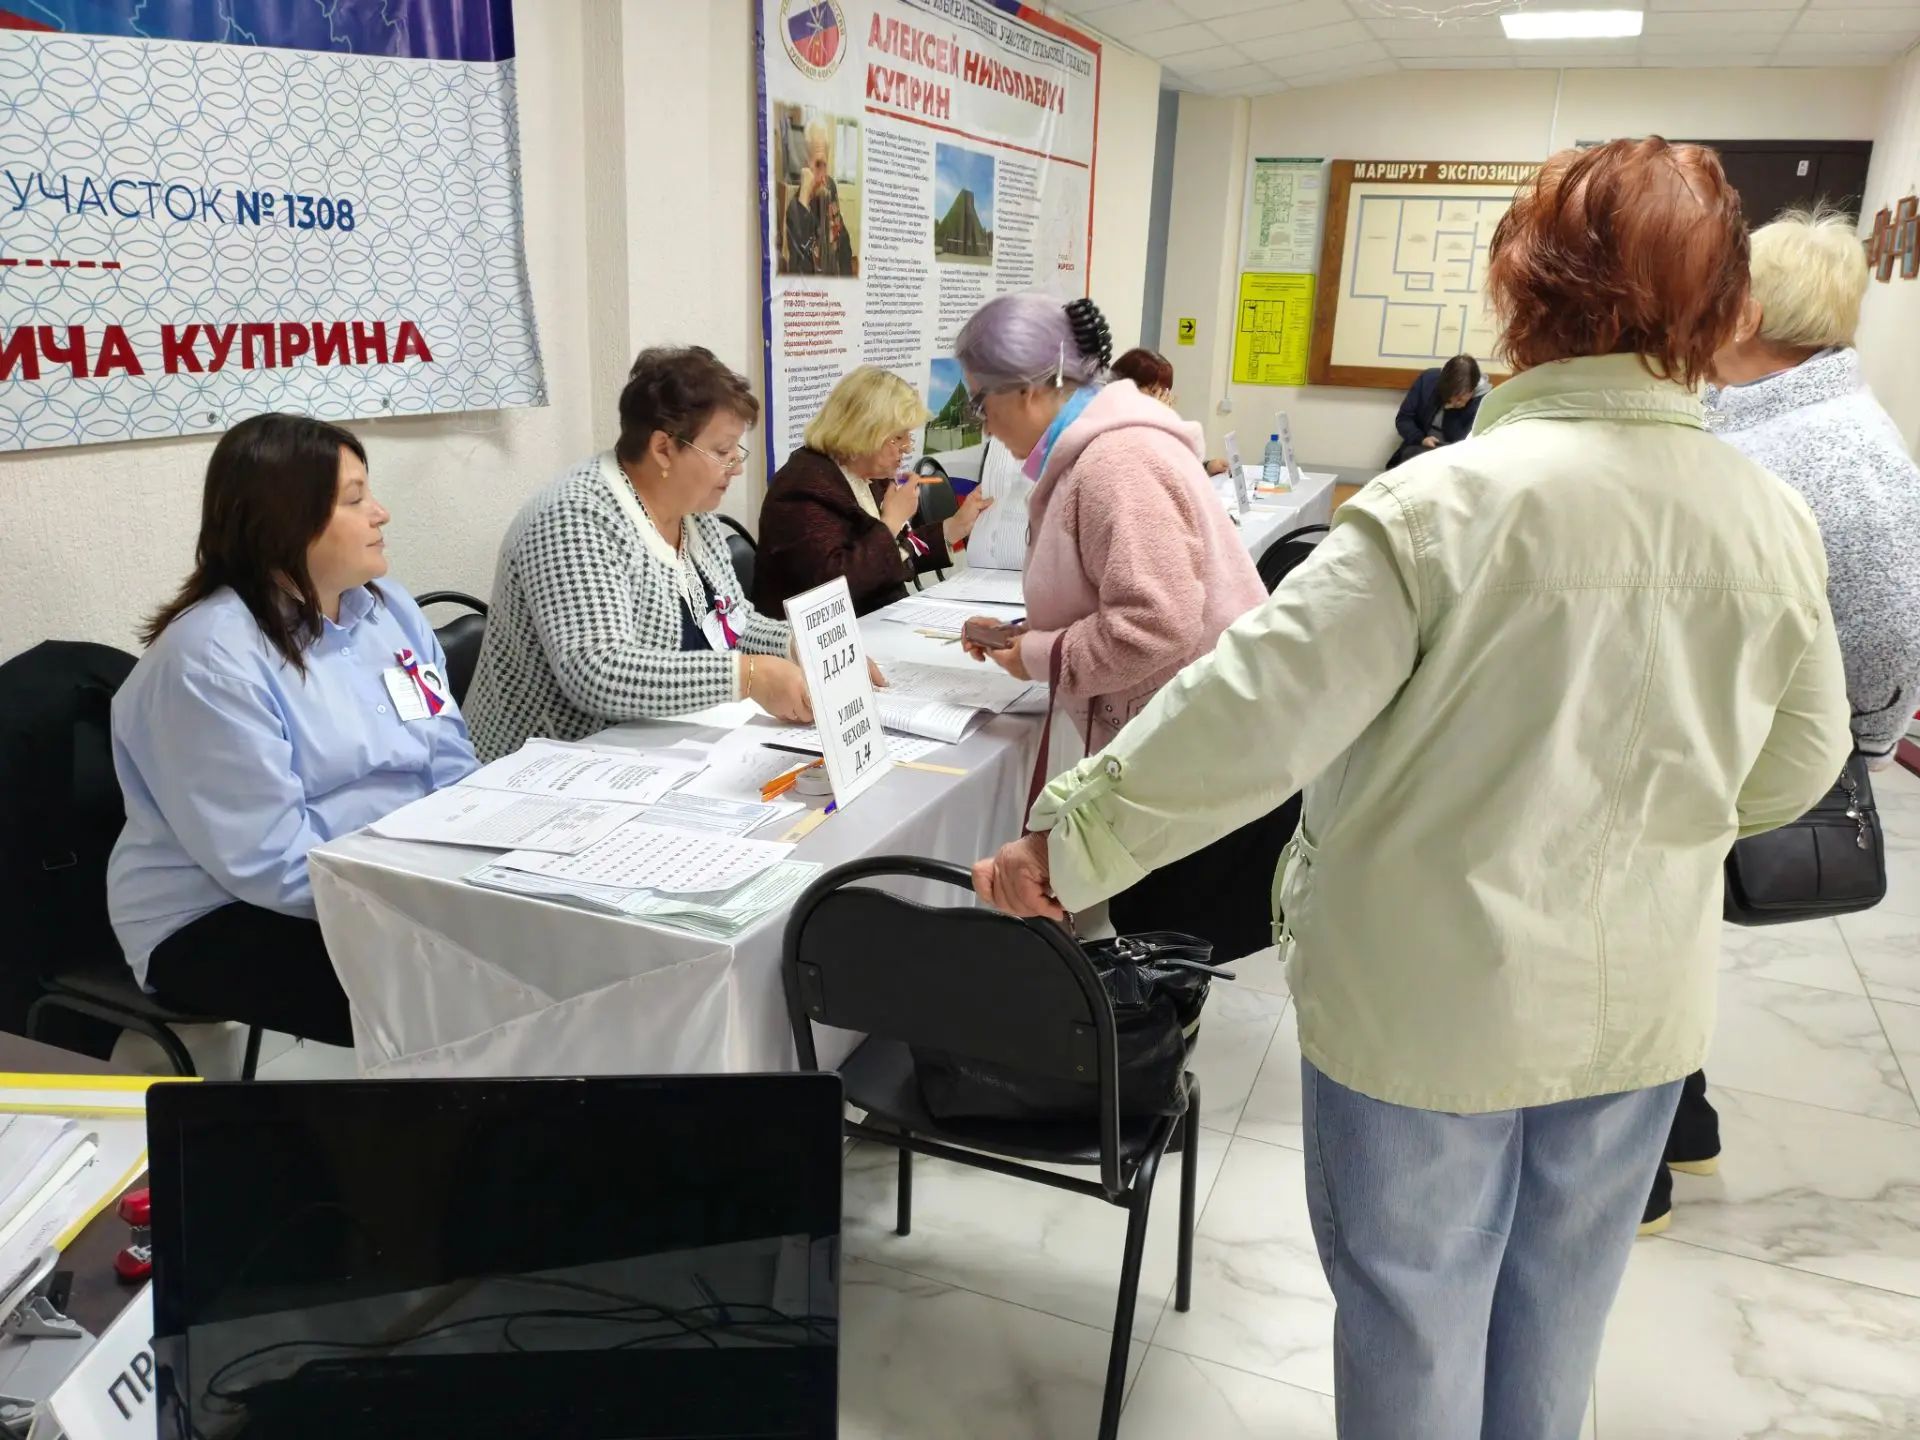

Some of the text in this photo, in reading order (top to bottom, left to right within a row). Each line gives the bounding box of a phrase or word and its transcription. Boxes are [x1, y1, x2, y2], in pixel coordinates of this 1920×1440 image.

[867, 12, 959, 78] АЛЕКСЕЙ
[866, 63, 950, 120] КУПРИН
[1354, 163, 1427, 180] МАРШРУТ
[5, 169, 355, 231] УЧАСТОК № 1308
[160, 320, 434, 374] КУПРИНА
[805, 597, 847, 631] ПЕРЕУЛОК
[817, 622, 848, 650] ЧЕХОВА
[838, 696, 864, 725] УЛИЦА
[842, 717, 871, 747] ЧЕХОВА
[855, 741, 871, 775] Д.4
